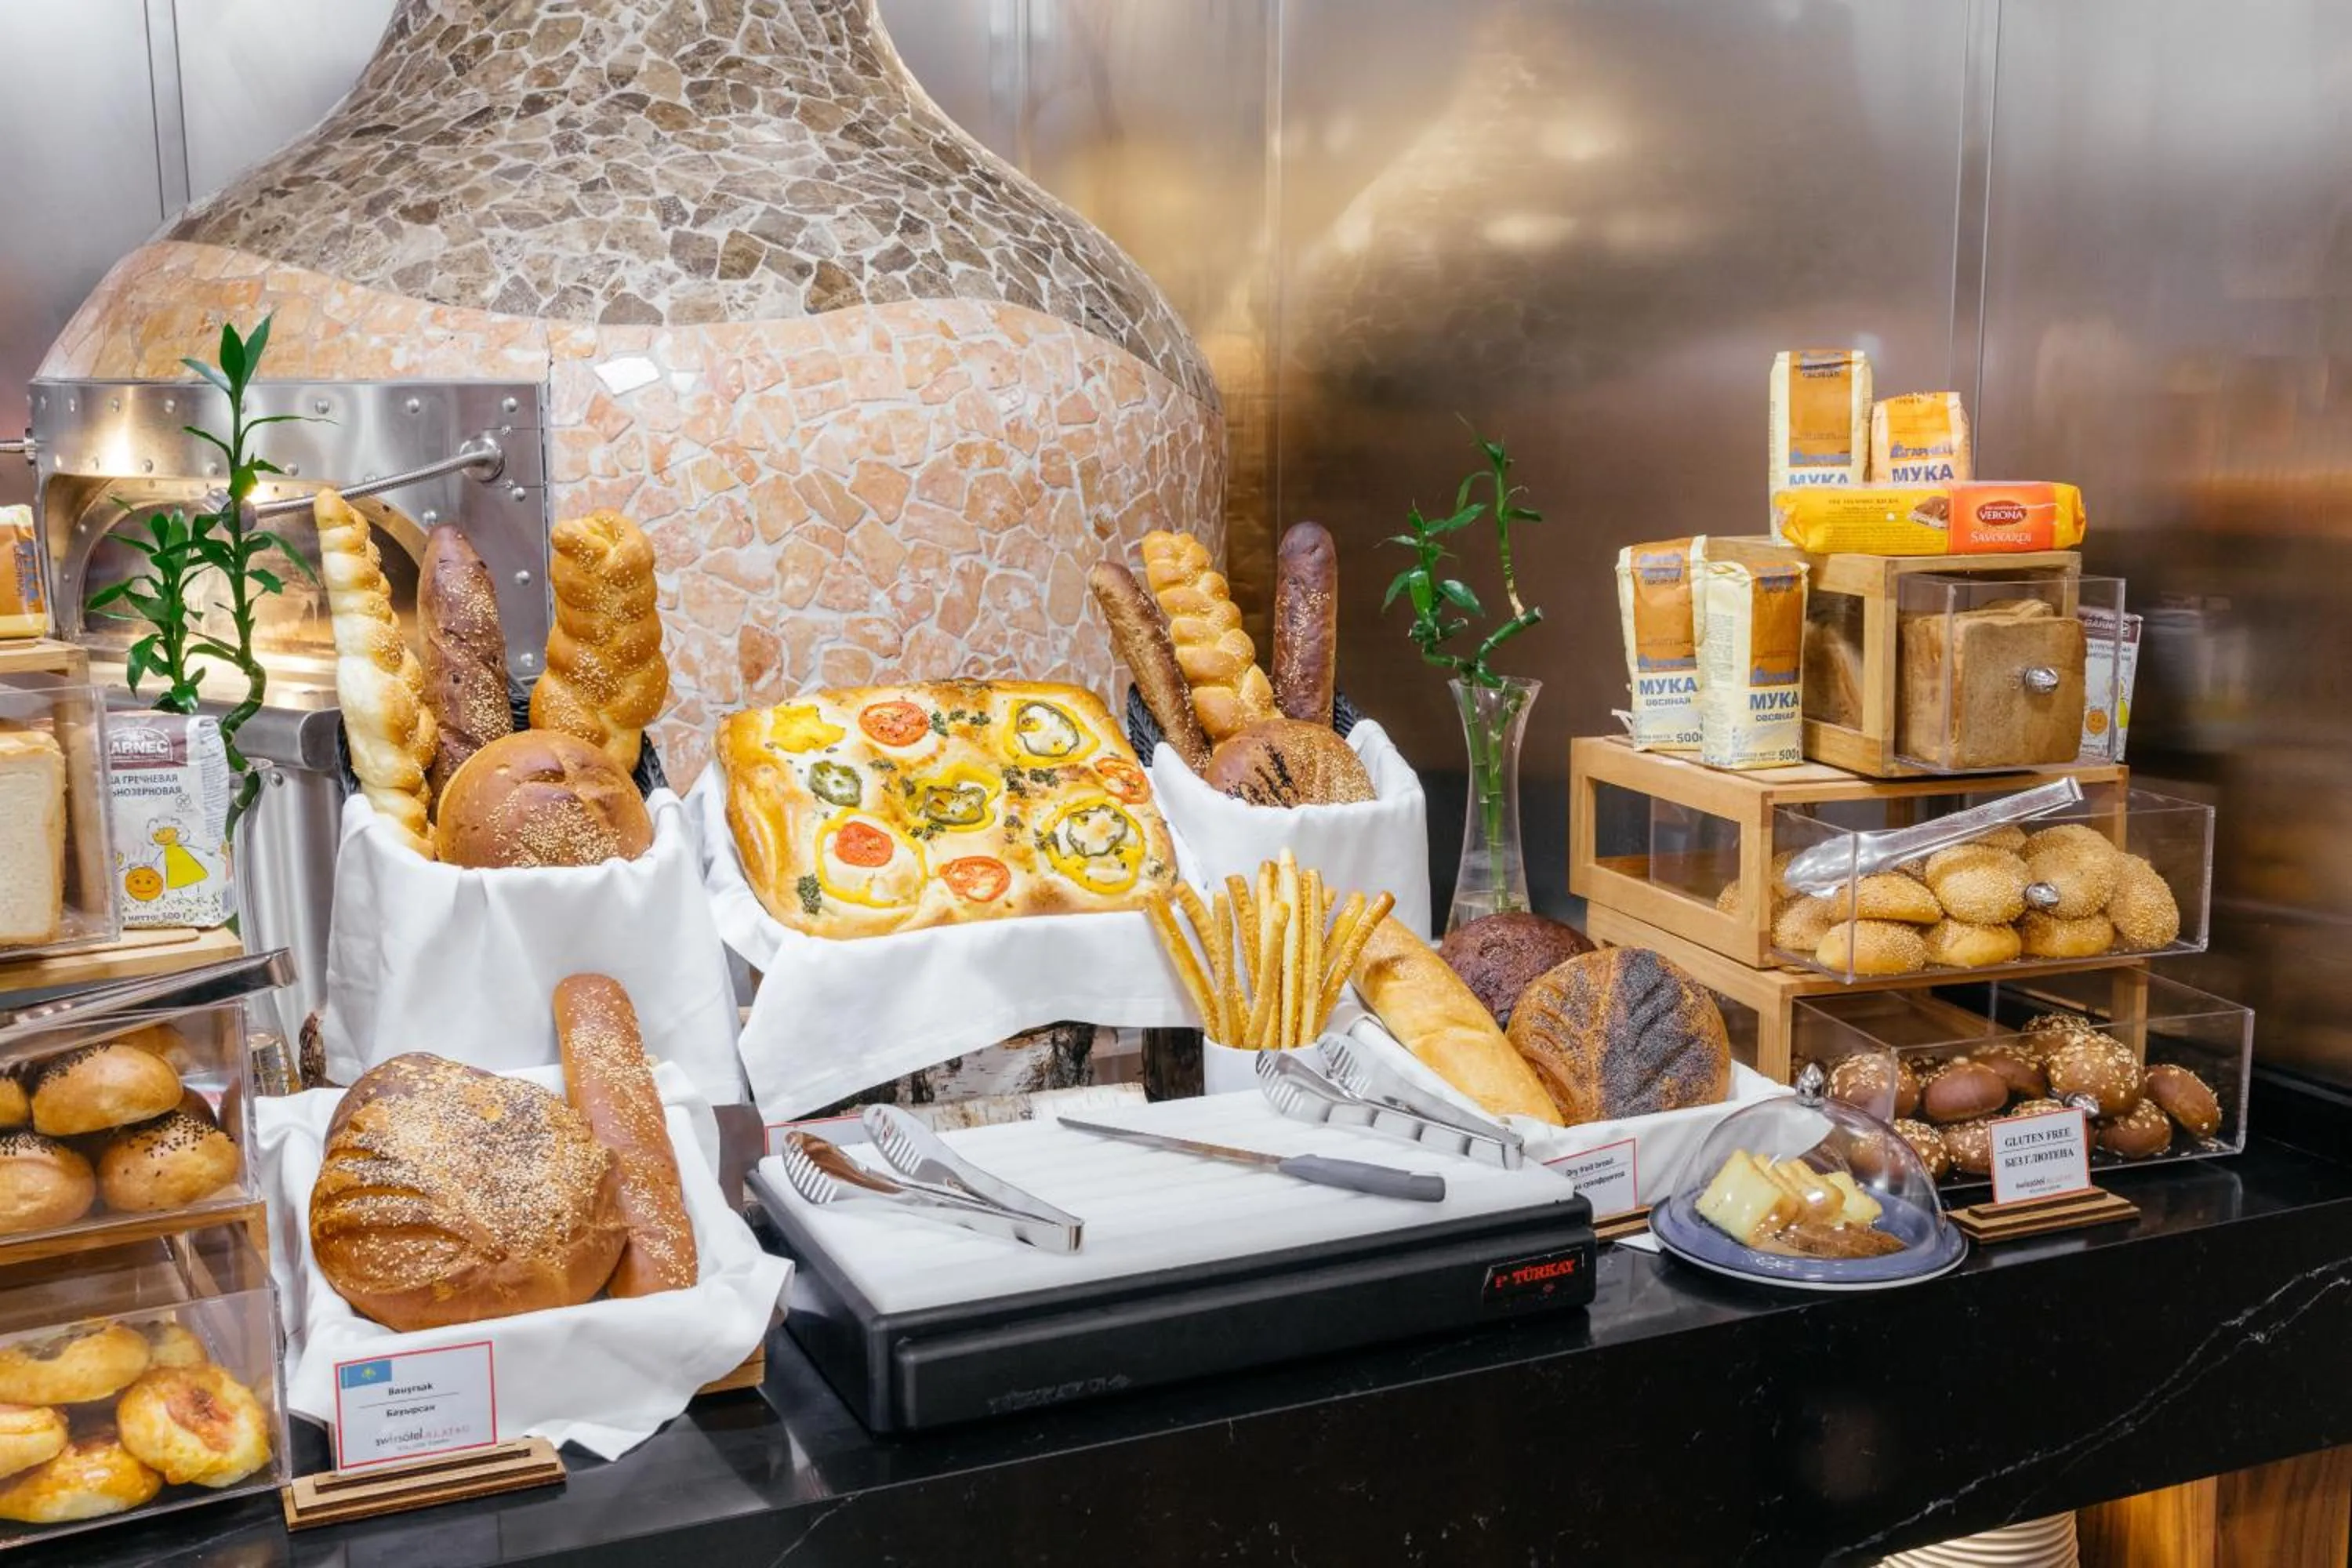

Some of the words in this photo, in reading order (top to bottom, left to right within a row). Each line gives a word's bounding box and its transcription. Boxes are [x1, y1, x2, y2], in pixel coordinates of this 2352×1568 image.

[1892, 464, 1954, 481] МУКА
[1979, 510, 2024, 521] VERONA
[1639, 677, 1697, 695] МУКА
[1749, 690, 1799, 710] МУКА
[110, 741, 168, 753] ARNEC
[2005, 1132, 2044, 1147] GLUTEN
[1512, 1258, 1575, 1285] TÜRKAY
